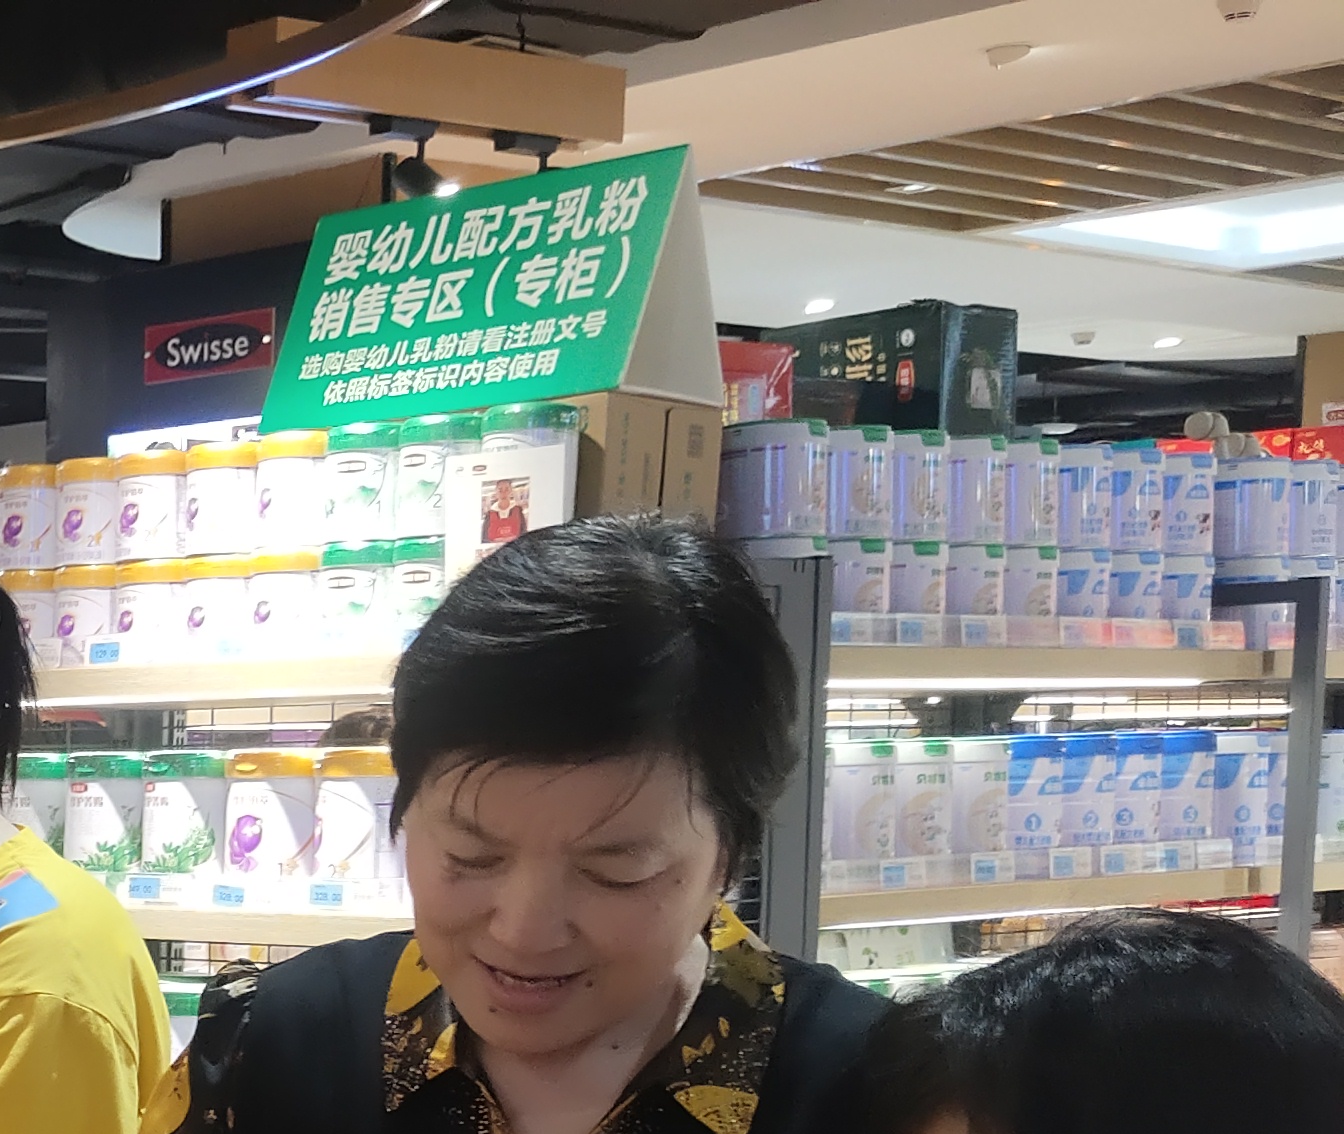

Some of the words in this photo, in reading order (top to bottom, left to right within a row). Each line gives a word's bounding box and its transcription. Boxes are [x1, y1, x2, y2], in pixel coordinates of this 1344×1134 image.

[324, 176, 649, 286] 婴幼儿配方乳粉
[309, 236, 633, 344] 销售专区（专柜）
[166, 329, 250, 368] Swisse
[298, 309, 608, 382] 选购婴幼儿乳粉请看注册文号
[322, 348, 558, 407] 依照标签标识内容使用
